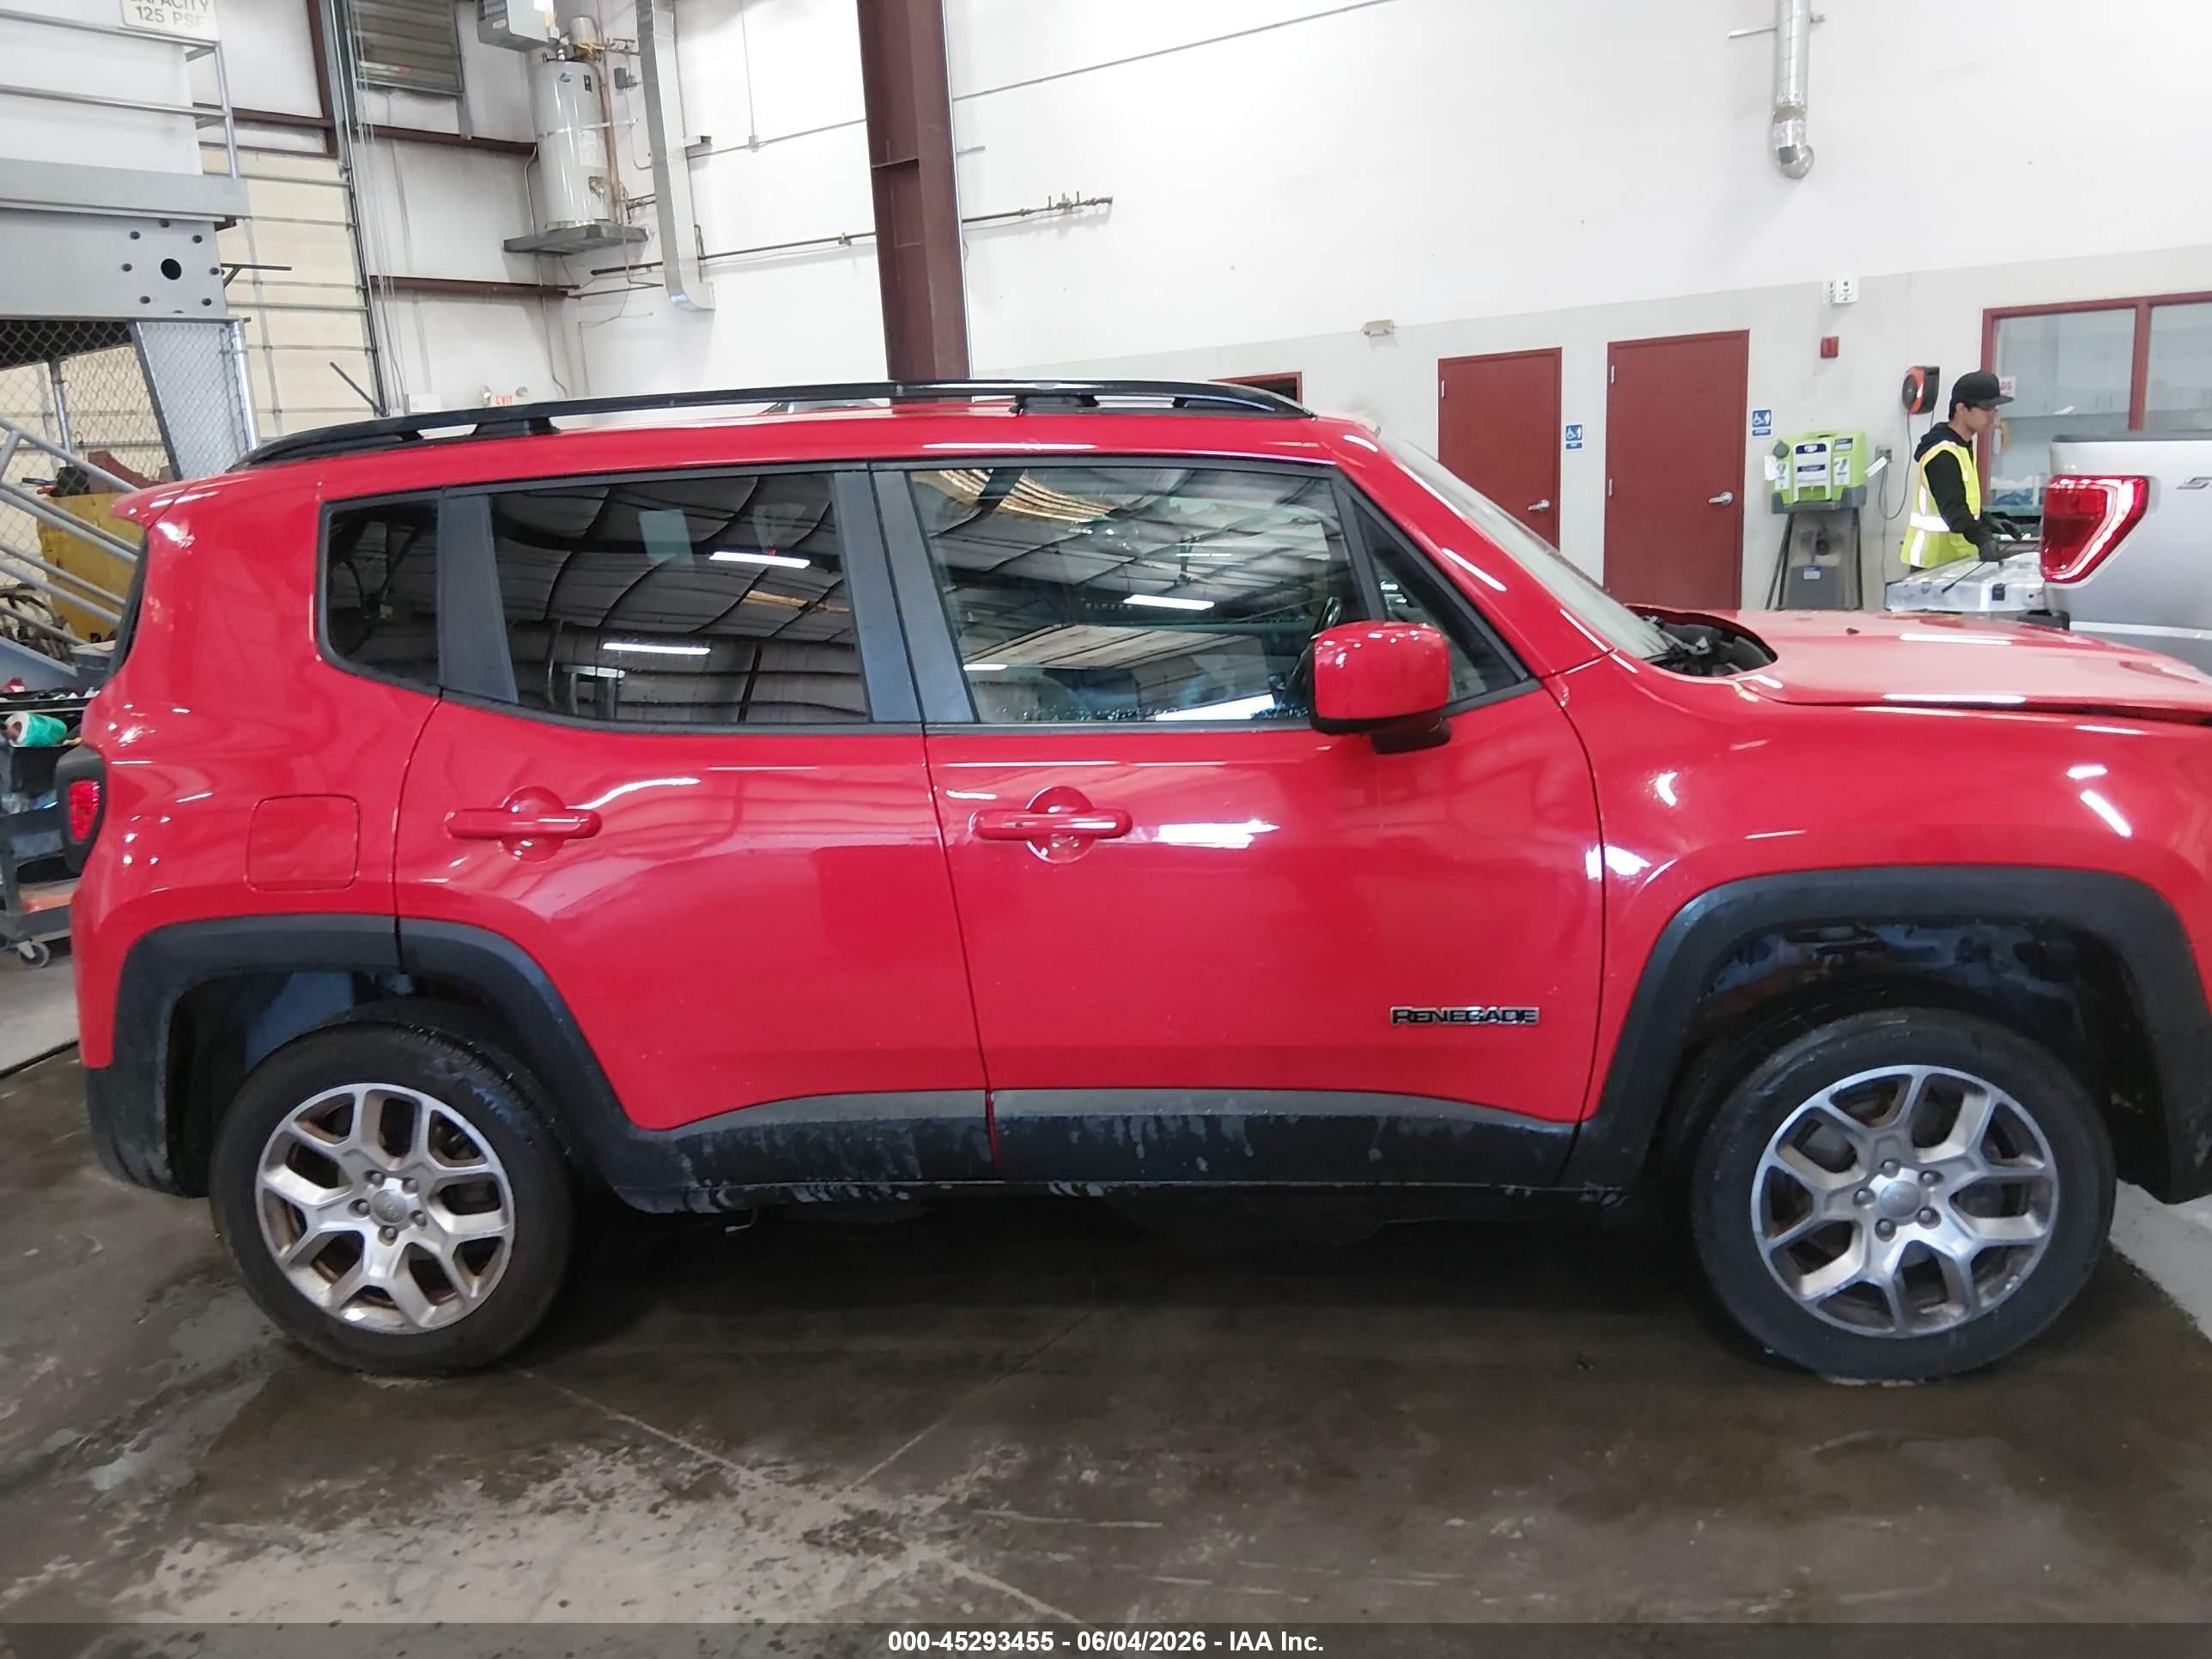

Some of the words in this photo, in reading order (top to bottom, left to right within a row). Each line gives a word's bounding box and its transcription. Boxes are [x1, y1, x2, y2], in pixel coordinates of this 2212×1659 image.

[130, 0, 209, 12] ACITY
[136, 6, 165, 23] 125
[1390, 1006, 1540, 1026] RENEGADE
